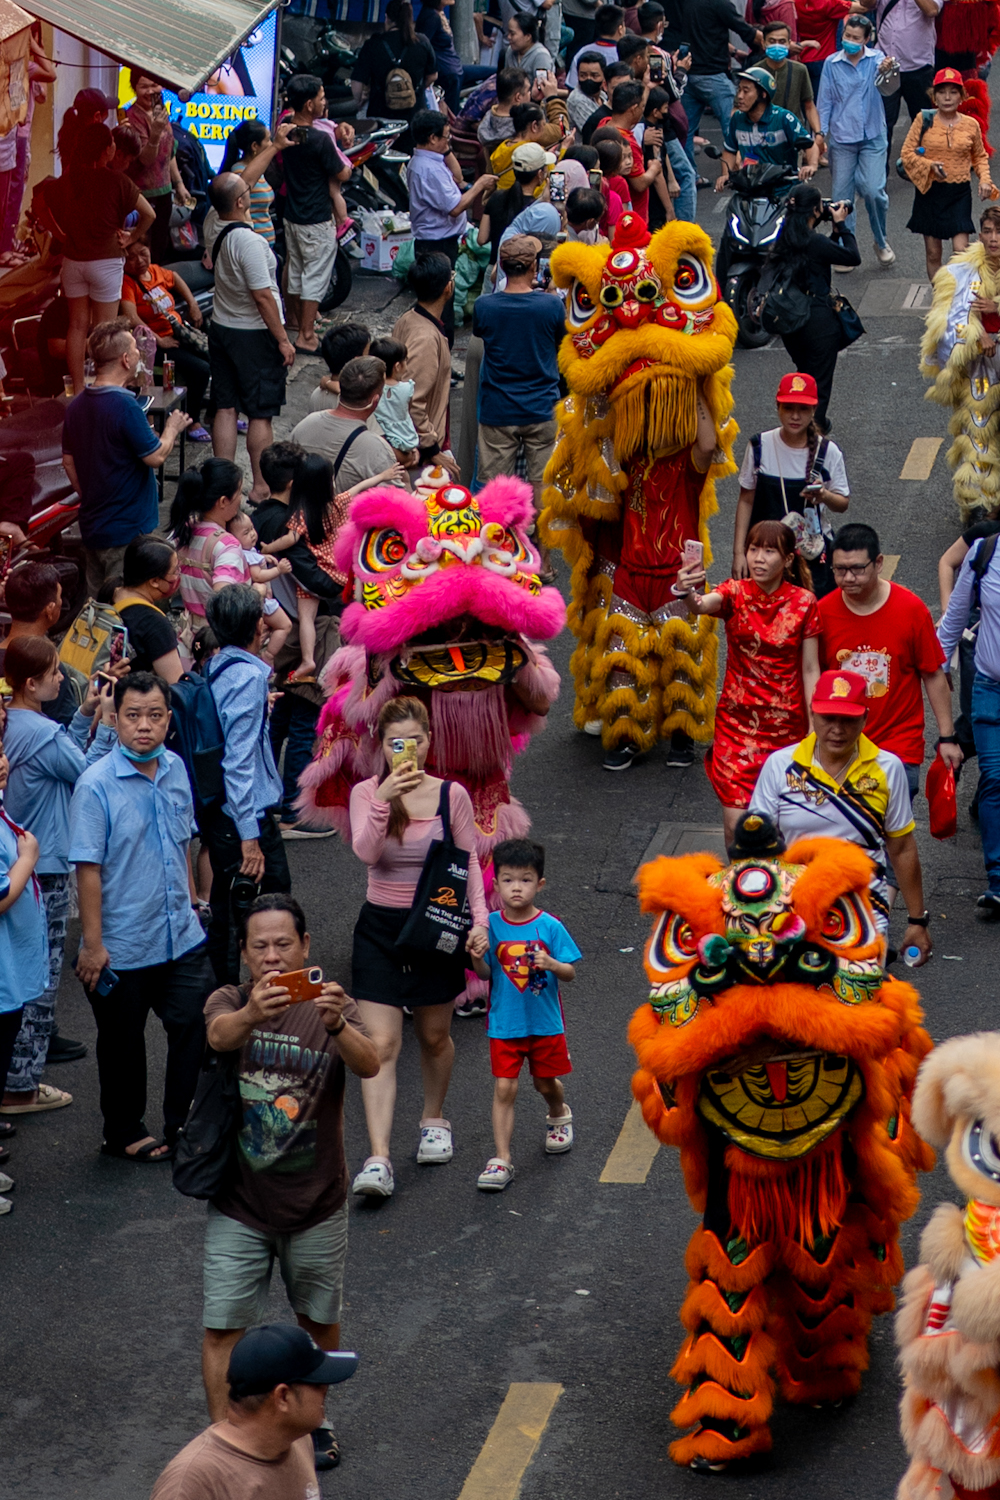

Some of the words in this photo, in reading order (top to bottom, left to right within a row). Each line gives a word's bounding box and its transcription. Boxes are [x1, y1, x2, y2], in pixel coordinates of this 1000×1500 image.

[186, 101, 257, 120] BOXING
[441, 909, 453, 919] THE
[263, 1032, 288, 1042] WONDER
[289, 1035, 300, 1043] OF
